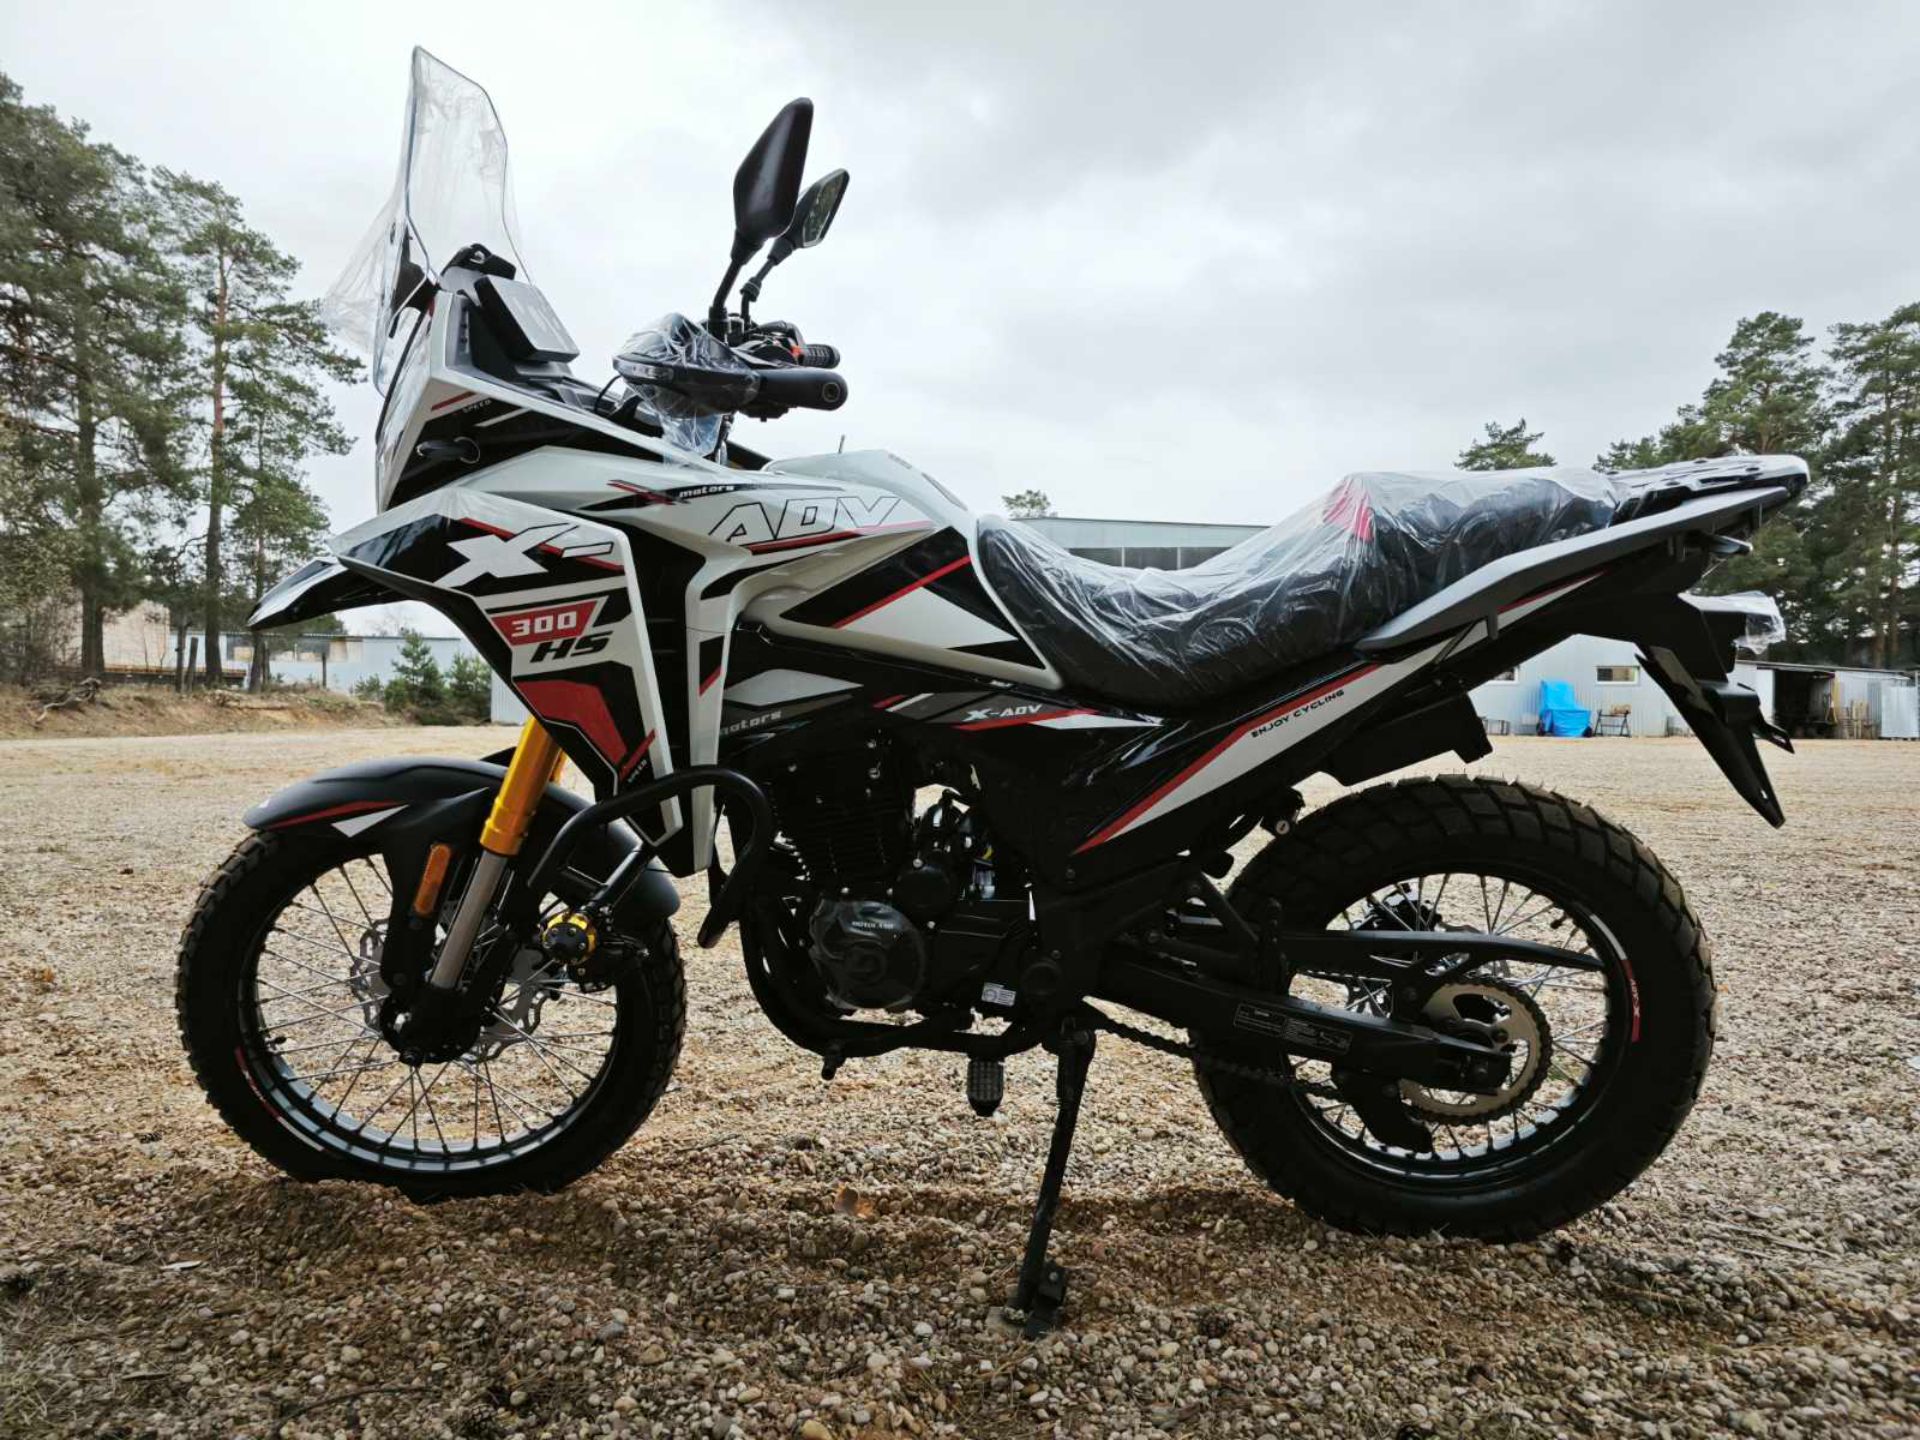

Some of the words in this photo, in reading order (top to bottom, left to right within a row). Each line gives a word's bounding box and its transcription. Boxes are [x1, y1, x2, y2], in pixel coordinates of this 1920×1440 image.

[679, 485, 735, 499] motors
[709, 496, 902, 547] ADV
[511, 611, 577, 637] 300
[529, 630, 613, 663] HS
[962, 704, 1043, 722] X-ADV
[1251, 715, 1290, 738] ENJOY
[1293, 689, 1345, 718] CYCLING
